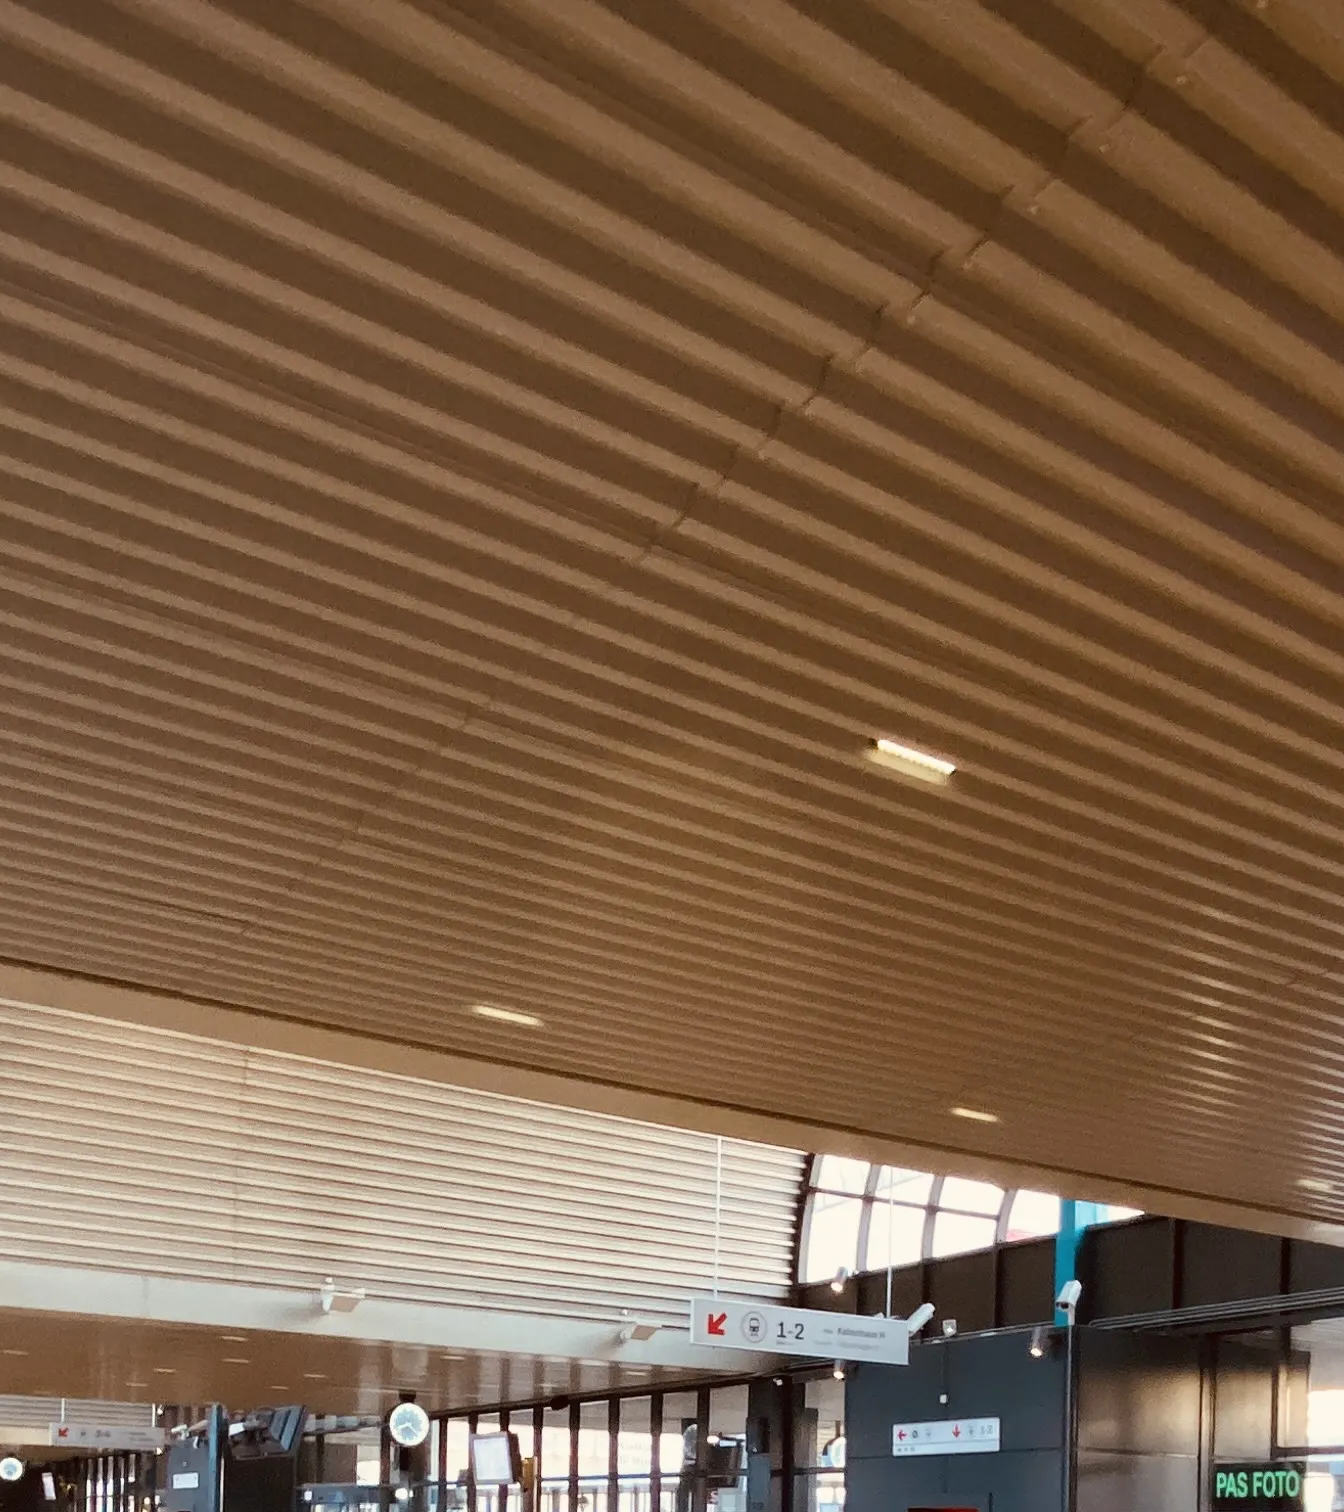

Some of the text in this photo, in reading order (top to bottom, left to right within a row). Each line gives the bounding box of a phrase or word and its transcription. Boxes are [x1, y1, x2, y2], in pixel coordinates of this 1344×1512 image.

[776, 1321, 805, 1340] 1-2
[1216, 1470, 1300, 1498] PAS FOTO
